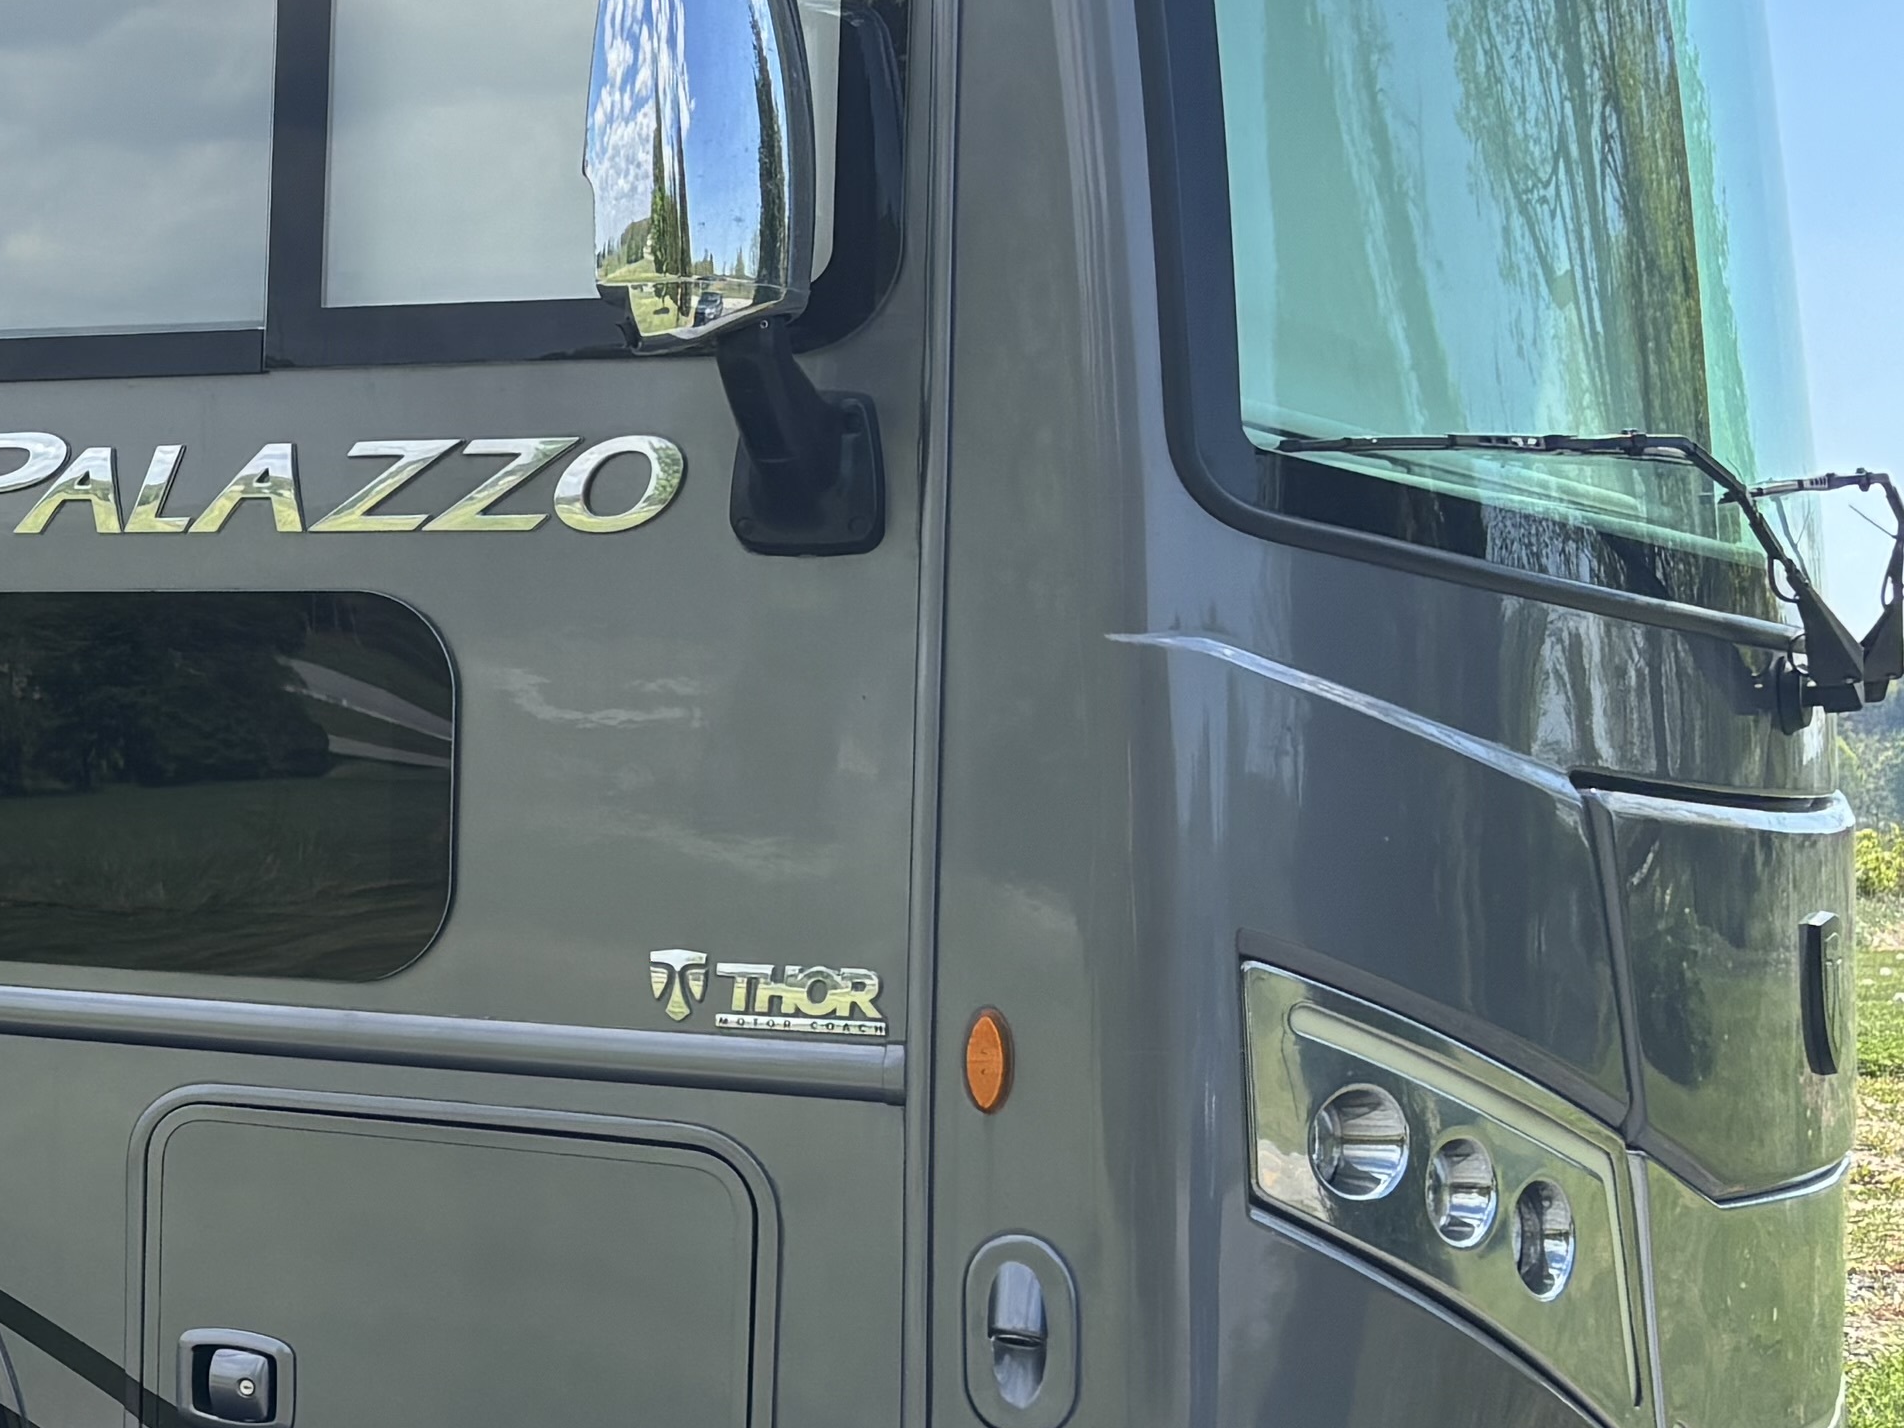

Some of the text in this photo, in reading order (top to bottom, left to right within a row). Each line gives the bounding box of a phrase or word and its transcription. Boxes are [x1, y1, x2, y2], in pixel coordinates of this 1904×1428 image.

[716, 962, 883, 1018] THOR
[718, 1016, 886, 1034] MOTOR COACH
